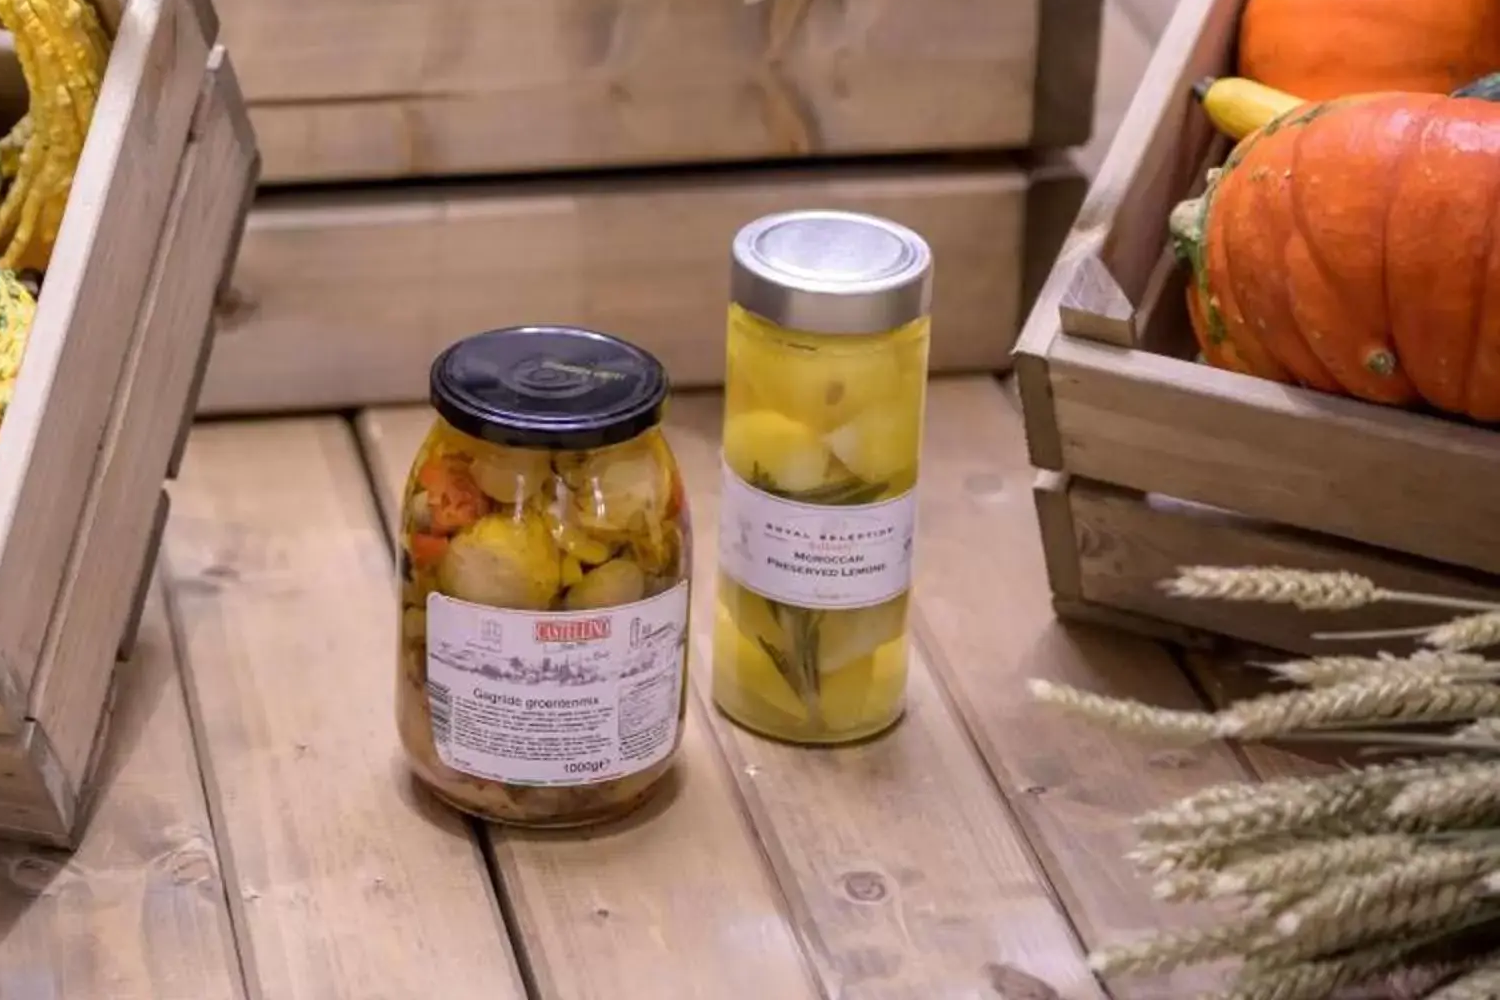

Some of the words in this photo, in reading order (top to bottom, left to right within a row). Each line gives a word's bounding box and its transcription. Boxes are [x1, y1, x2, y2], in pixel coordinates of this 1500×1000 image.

[765, 522, 810, 539] ROYAL
[794, 551, 864, 565] MOROCCAN
[767, 556, 839, 577] PRESERVED
[525, 697, 599, 710] groentenmix
